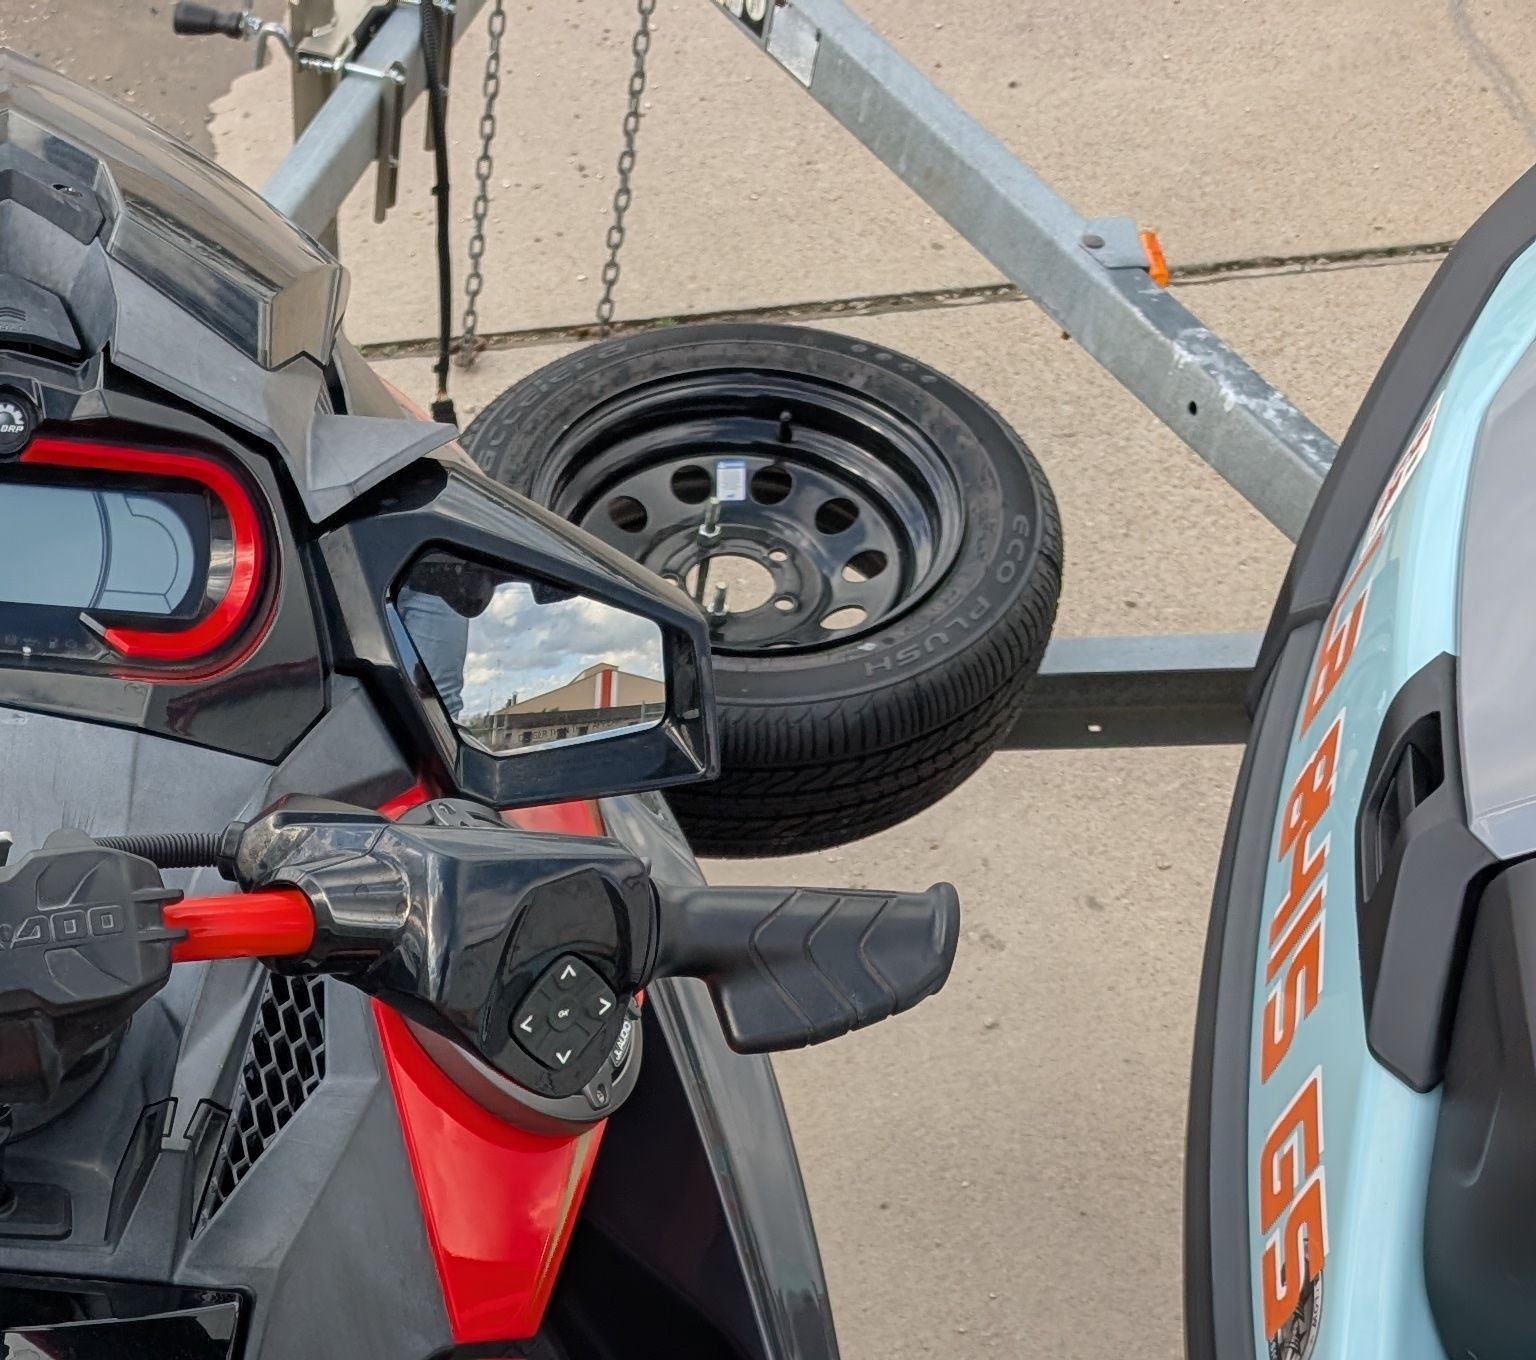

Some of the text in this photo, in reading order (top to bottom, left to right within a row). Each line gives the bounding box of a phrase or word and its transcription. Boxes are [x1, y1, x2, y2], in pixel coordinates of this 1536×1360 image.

[864, 514, 1030, 677] ECO PLUSH
[1259, 1064, 1331, 1342] GS
